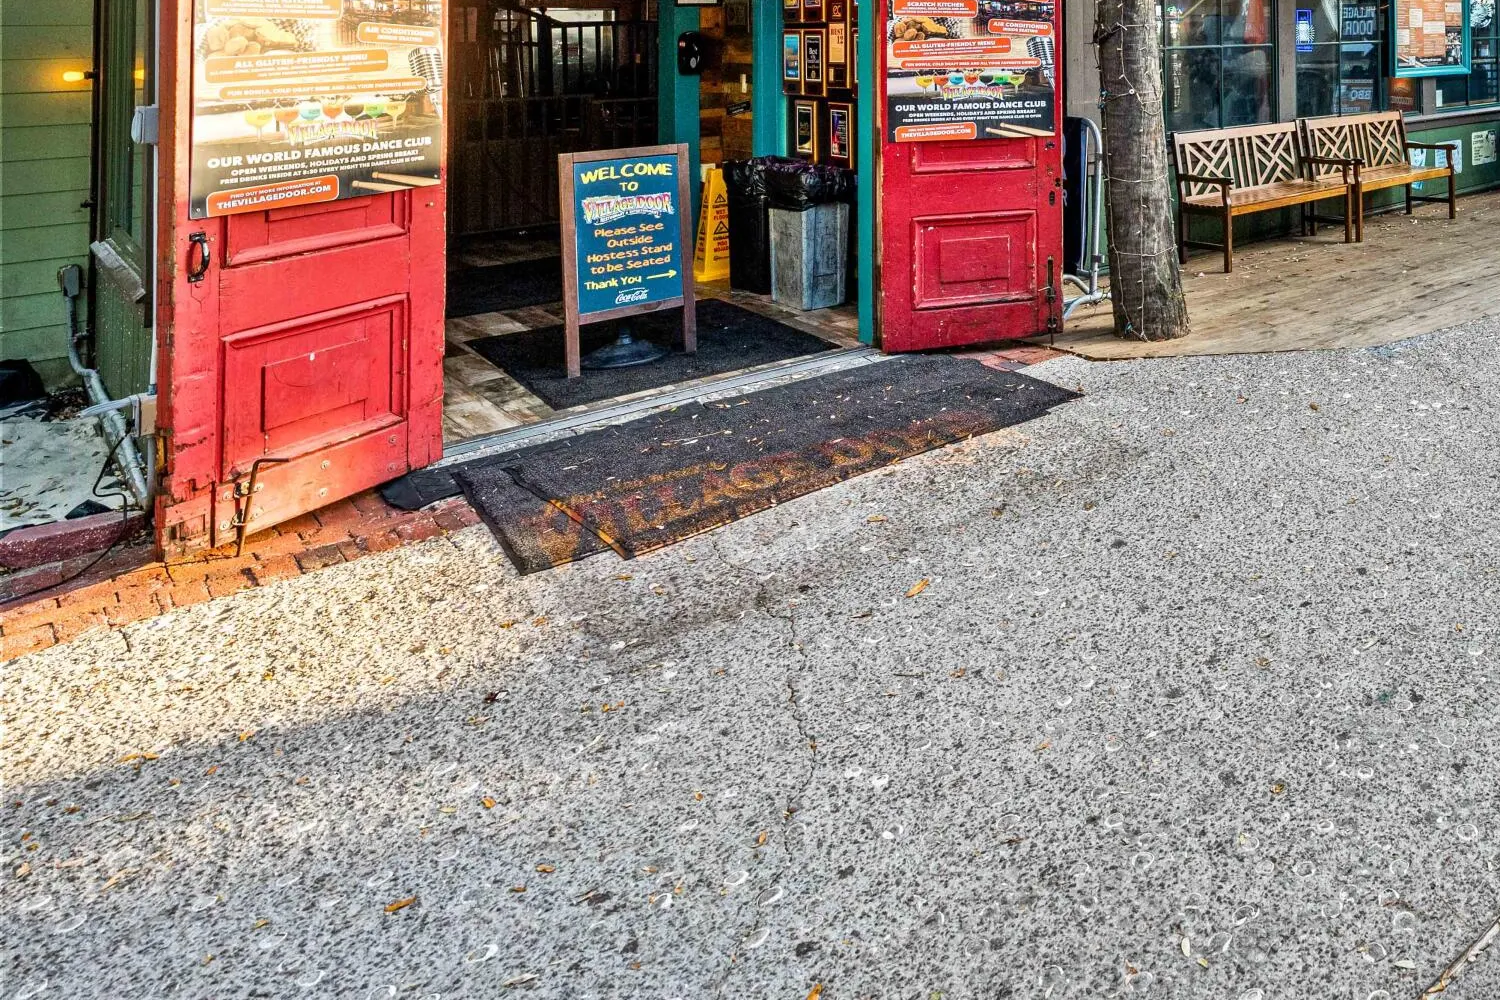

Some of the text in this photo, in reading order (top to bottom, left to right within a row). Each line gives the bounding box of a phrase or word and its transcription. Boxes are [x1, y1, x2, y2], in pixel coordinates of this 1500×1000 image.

[208, 137, 432, 169] OUR WORLD FAMOUS DANCE CLUB
[581, 163, 673, 184] WELCOME
[619, 182, 639, 191] TO
[582, 192, 674, 224] VILLAGE DOOR
[594, 223, 664, 238] Please See
[607, 235, 653, 249] Outside
[587, 243, 673, 263] Hostess Stand
[591, 255, 671, 274] to be Seated
[584, 275, 642, 291] Thank You
